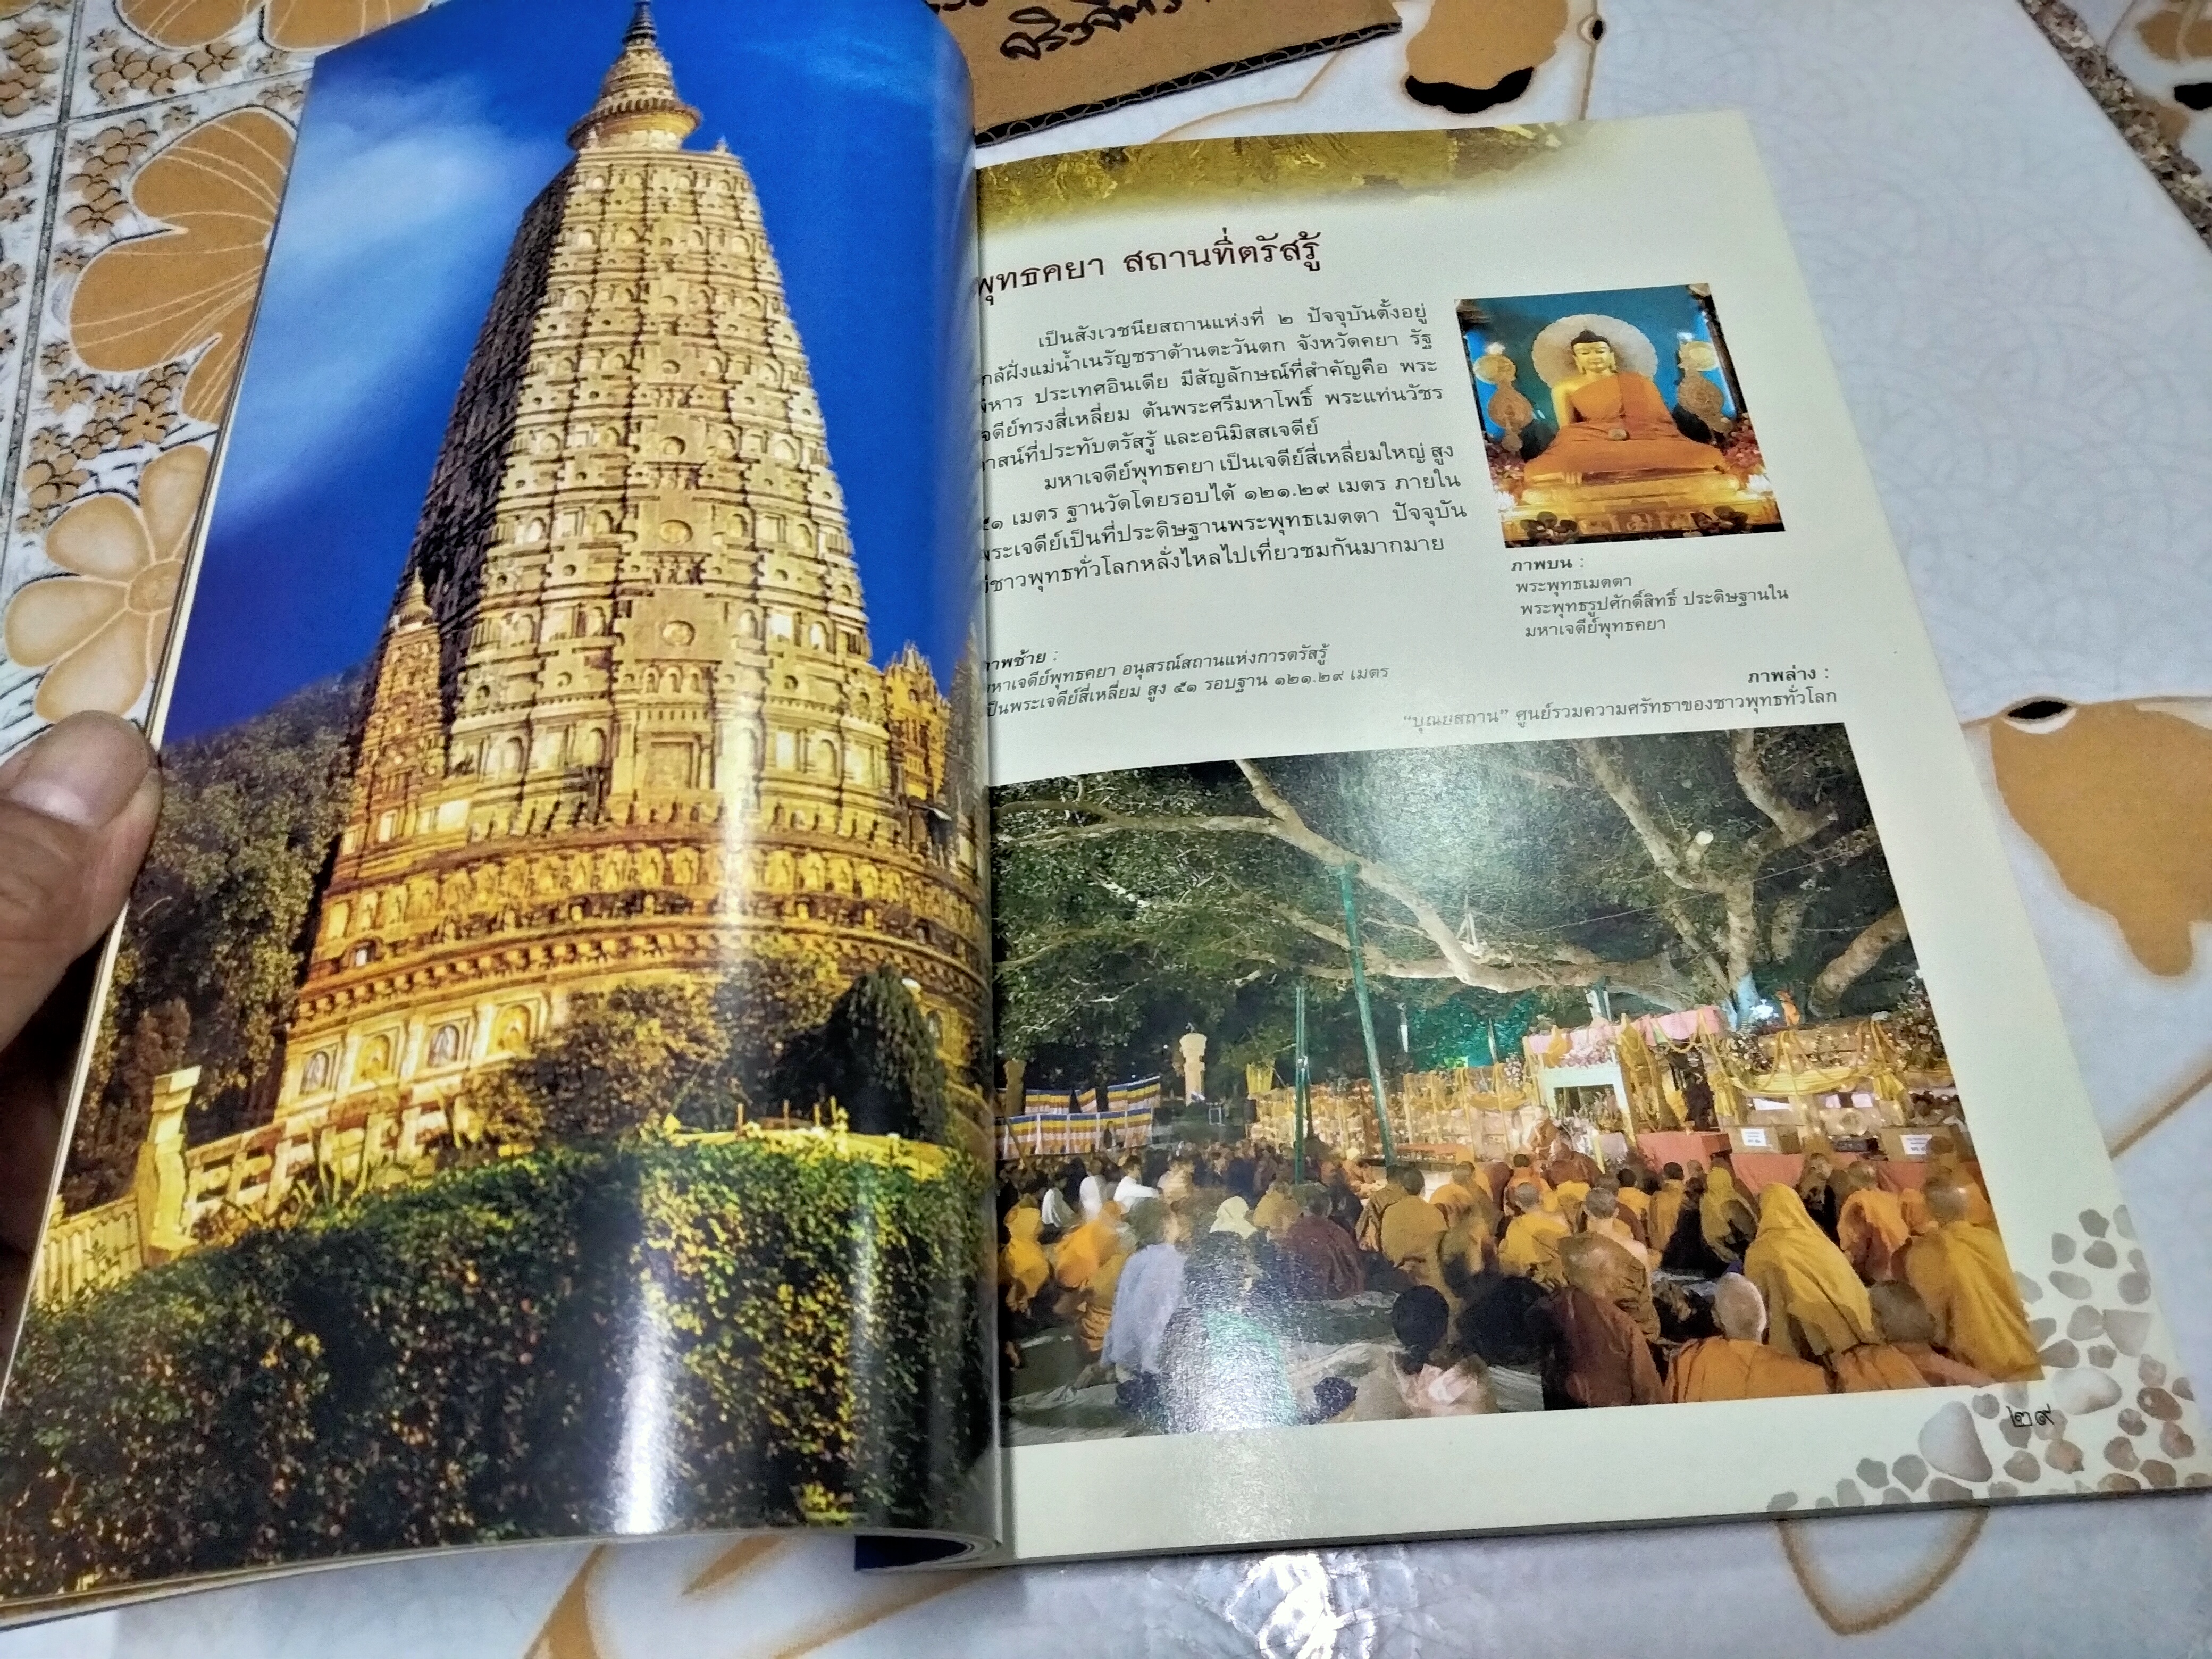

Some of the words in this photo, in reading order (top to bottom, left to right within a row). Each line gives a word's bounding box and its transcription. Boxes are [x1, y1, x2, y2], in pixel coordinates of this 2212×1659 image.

[1122, 226, 1322, 273] สถานที่ตรัสรู้
[1277, 313, 1294, 325] ๒
[1306, 298, 1428, 329] ปัจจุบันตั้งอยู่
[1296, 331, 1400, 351] จังหวัดคยา
[1409, 328, 1433, 350] รัฐ
[1034, 371, 1168, 404] ประเทศอินเดีย
[1399, 361, 1438, 376] พระ
[1142, 384, 1314, 418] ต้นพระศรีมหาโพธิ์
[1324, 383, 1444, 406] พระแท่นวัชร
[982, 430, 1158, 471] าสน์ที่ประทับตรัสรู้
[1164, 415, 1320, 446] และอนิมิสสเจดีย์
[1044, 459, 1214, 490] มหาเจดีย์พุทธคยา
[1220, 439, 1426, 471] เป็นเจดีย์สี่เหลี่ยมใหญ่
[1430, 445, 1454, 466] สูง
[1012, 507, 1059, 526] เมตร
[1066, 482, 1237, 524] ฐานวัดโดยรอบได้
[1244, 481, 1330, 501] ๑๒๑.๒๙
[1338, 479, 1387, 493] เมตร
[1395, 468, 1462, 490] ภายใน
[1391, 499, 1468, 527] ปัจจุบัน
[1511, 558, 1573, 572] ภาพบน
[1515, 576, 1632, 599] พระพุทธเมตตา
[1520, 586, 1679, 619] พระพุทธรูปศักดิ์สิทธิ์
[1682, 583, 1789, 607] ประดิษฐานใน
[1524, 616, 1666, 639] มหาเจดีย์พุทธคยา
[987, 666, 1116, 694] หาเจดีย์พุทธคยา
[1147, 684, 1167, 702] สูง
[1173, 681, 1197, 693] ๕๑
[1204, 675, 1269, 693] รอบฐาน
[1275, 669, 1345, 686] ๑๒๑.๒๙
[1350, 667, 1390, 681] เมตร
[1747, 664, 1817, 684] ภาพล่าง
[2006, 1404, 2055, 1428] ๒๙
